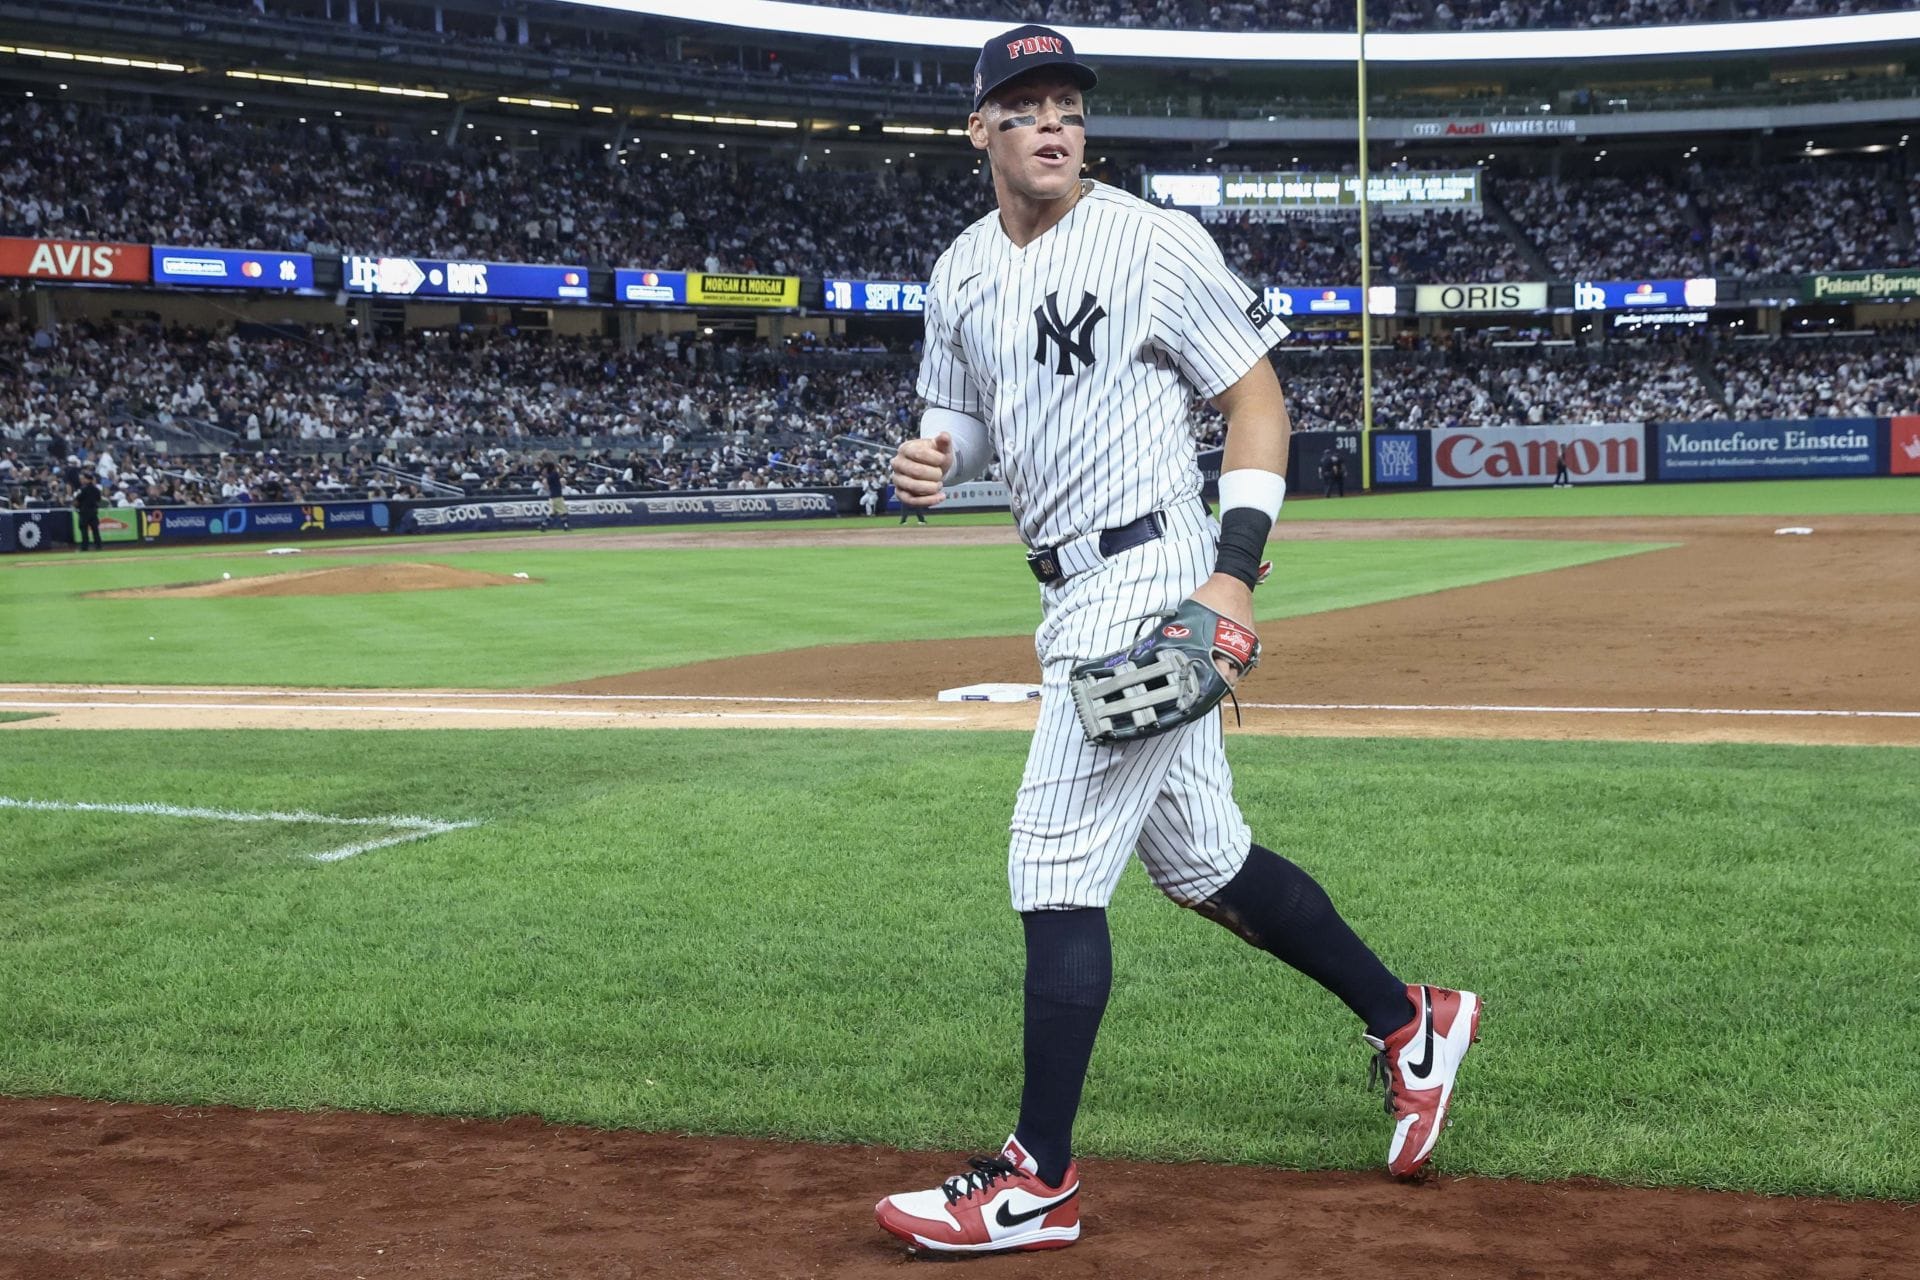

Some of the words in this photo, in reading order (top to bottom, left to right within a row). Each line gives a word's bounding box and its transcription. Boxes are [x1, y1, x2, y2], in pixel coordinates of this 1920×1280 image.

[1007, 36, 1063, 59] FDNY
[1446, 122, 1484, 135] Audi
[1491, 120, 1543, 134] YANKEES
[1546, 119, 1576, 133] CLUB
[28, 244, 114, 278] AVIS
[705, 277, 740, 292] MORGAN
[741, 279, 747, 292] &
[748, 279, 783, 294] MORGAN
[1815, 274, 1871, 298] Poland
[865, 284, 901, 310] SEPT
[1441, 285, 1520, 309] ORIS
[1642, 313, 1674, 324] SPORTS
[1675, 312, 1708, 323] LOUNGE
[1033, 290, 1107, 376] NY
[1336, 436, 1357, 449] 318
[1382, 440, 1411, 453] NEW
[1666, 431, 1780, 454] Montefiore
[1784, 429, 1869, 450] Einstein
[1378, 451, 1414, 465] YORK
[1435, 434, 1639, 479] Canon
[1383, 464, 1411, 477] LIFE
[522, 503, 551, 517] COO
[595, 502, 632, 515] COOL
[674, 500, 708, 513] COOL
[739, 499, 772, 511] COOL
[800, 498, 831, 510] COOL
[446, 506, 487, 523] COOL
